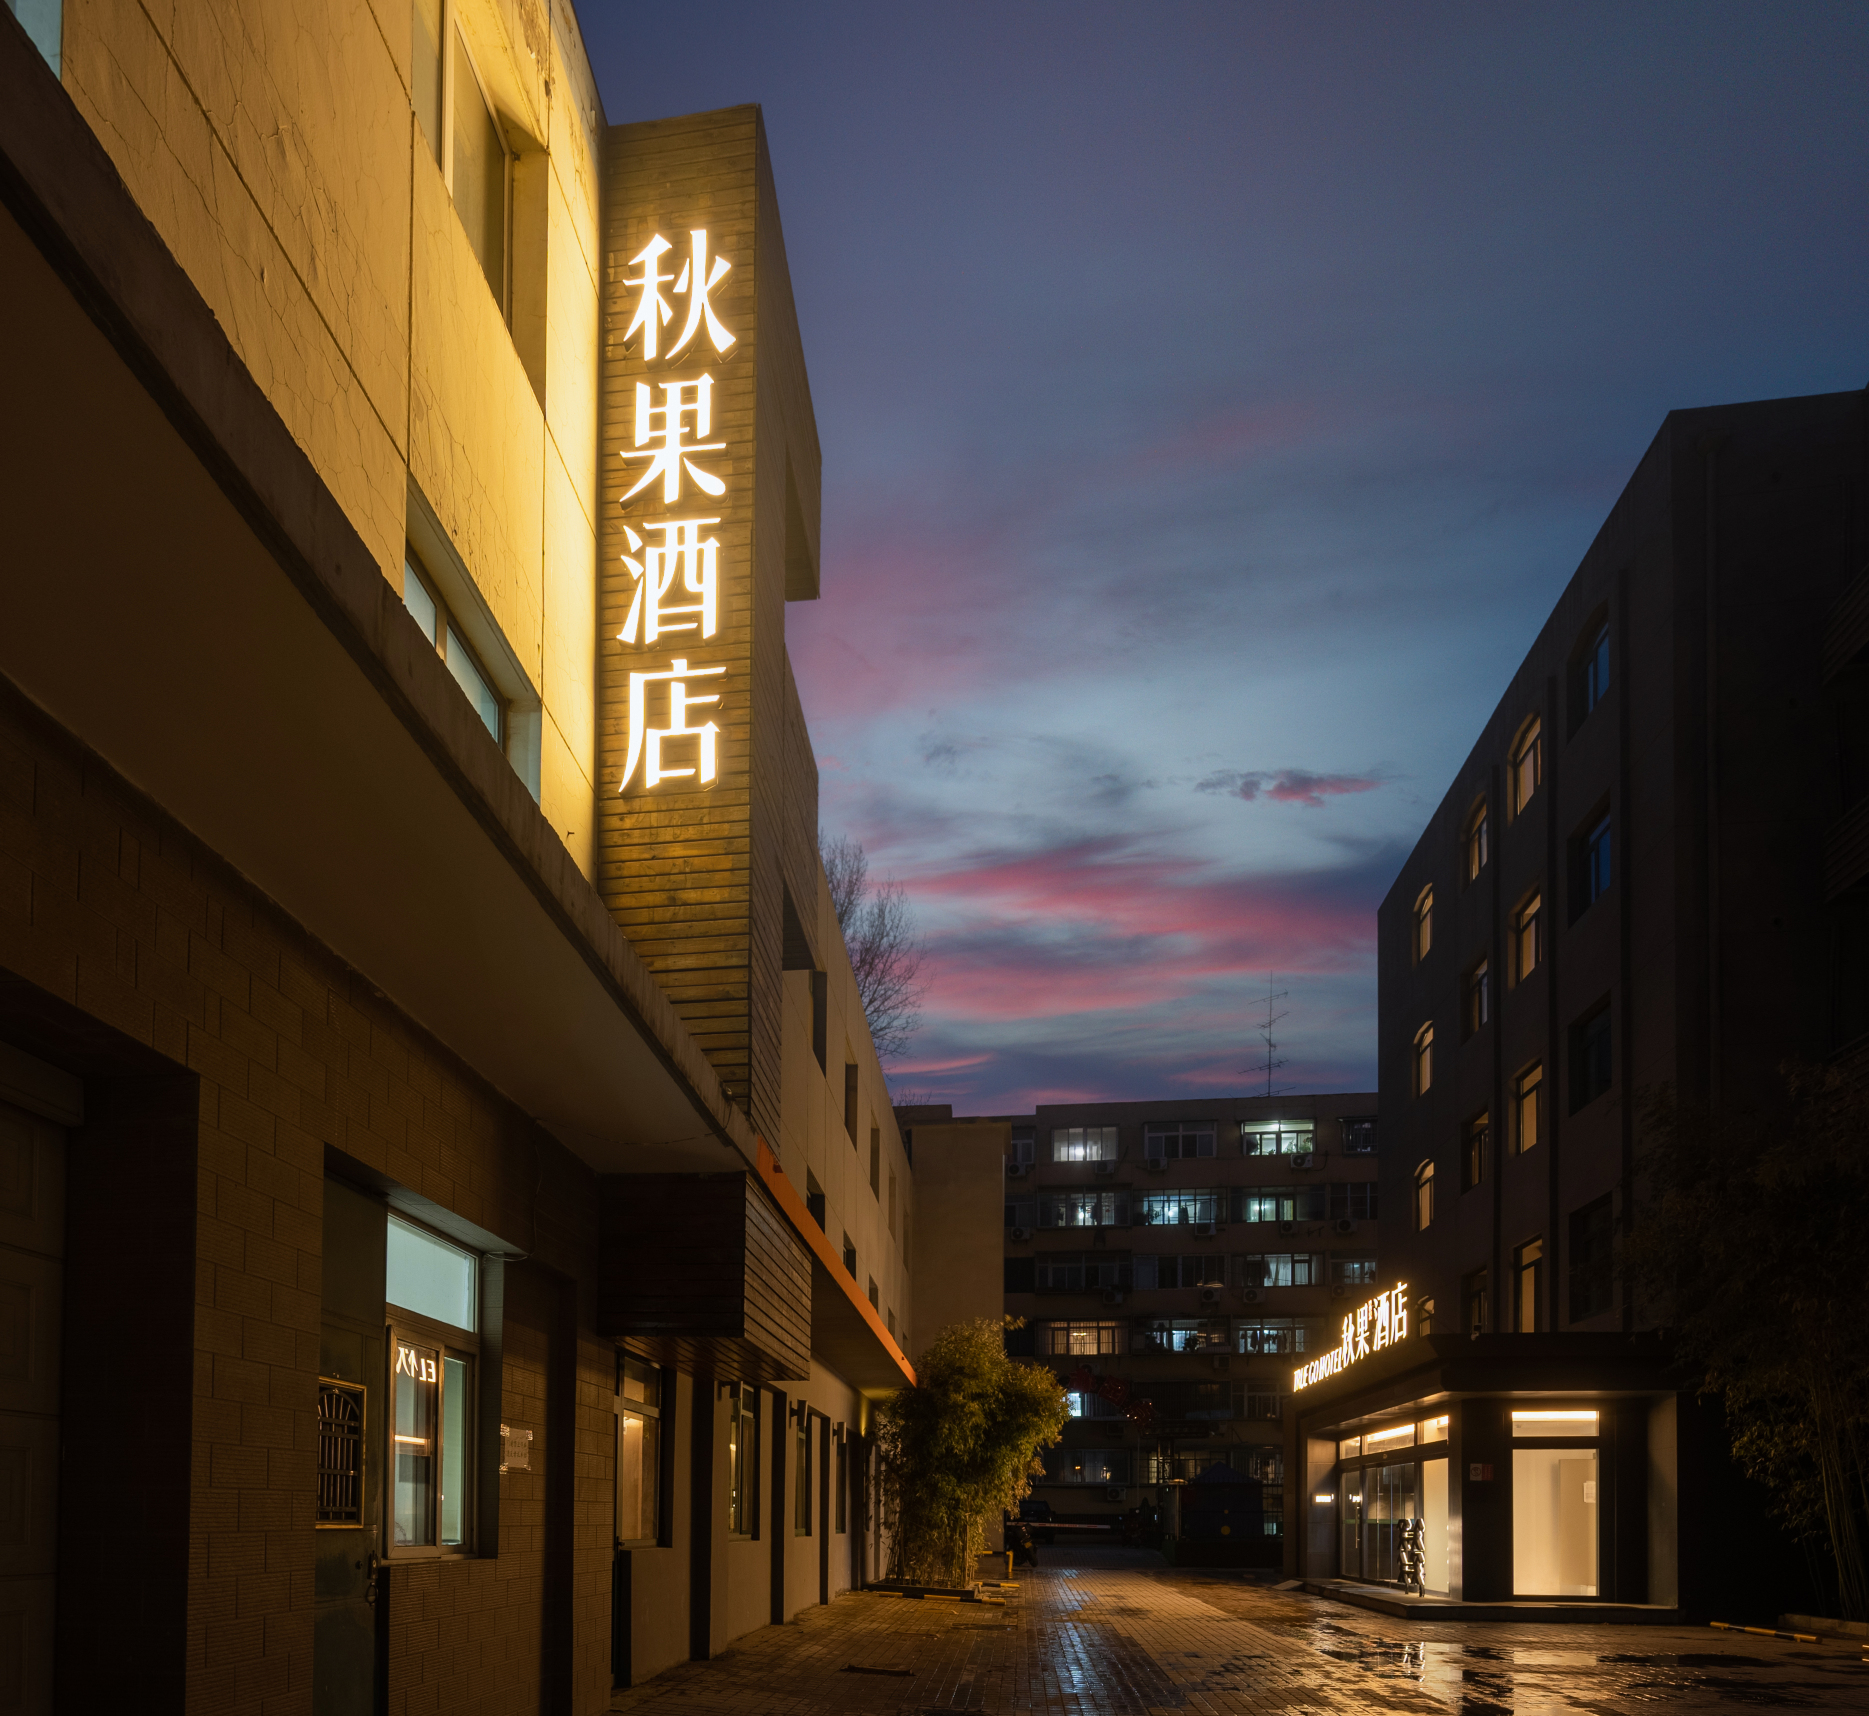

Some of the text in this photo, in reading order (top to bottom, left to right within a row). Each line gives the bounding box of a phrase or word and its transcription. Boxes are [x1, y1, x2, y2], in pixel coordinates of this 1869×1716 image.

[616, 228, 736, 793] 秋果酒店
[1318, 1346, 1342, 1381] HOTEL
[1341, 1281, 1408, 1369] 秋果酒店
